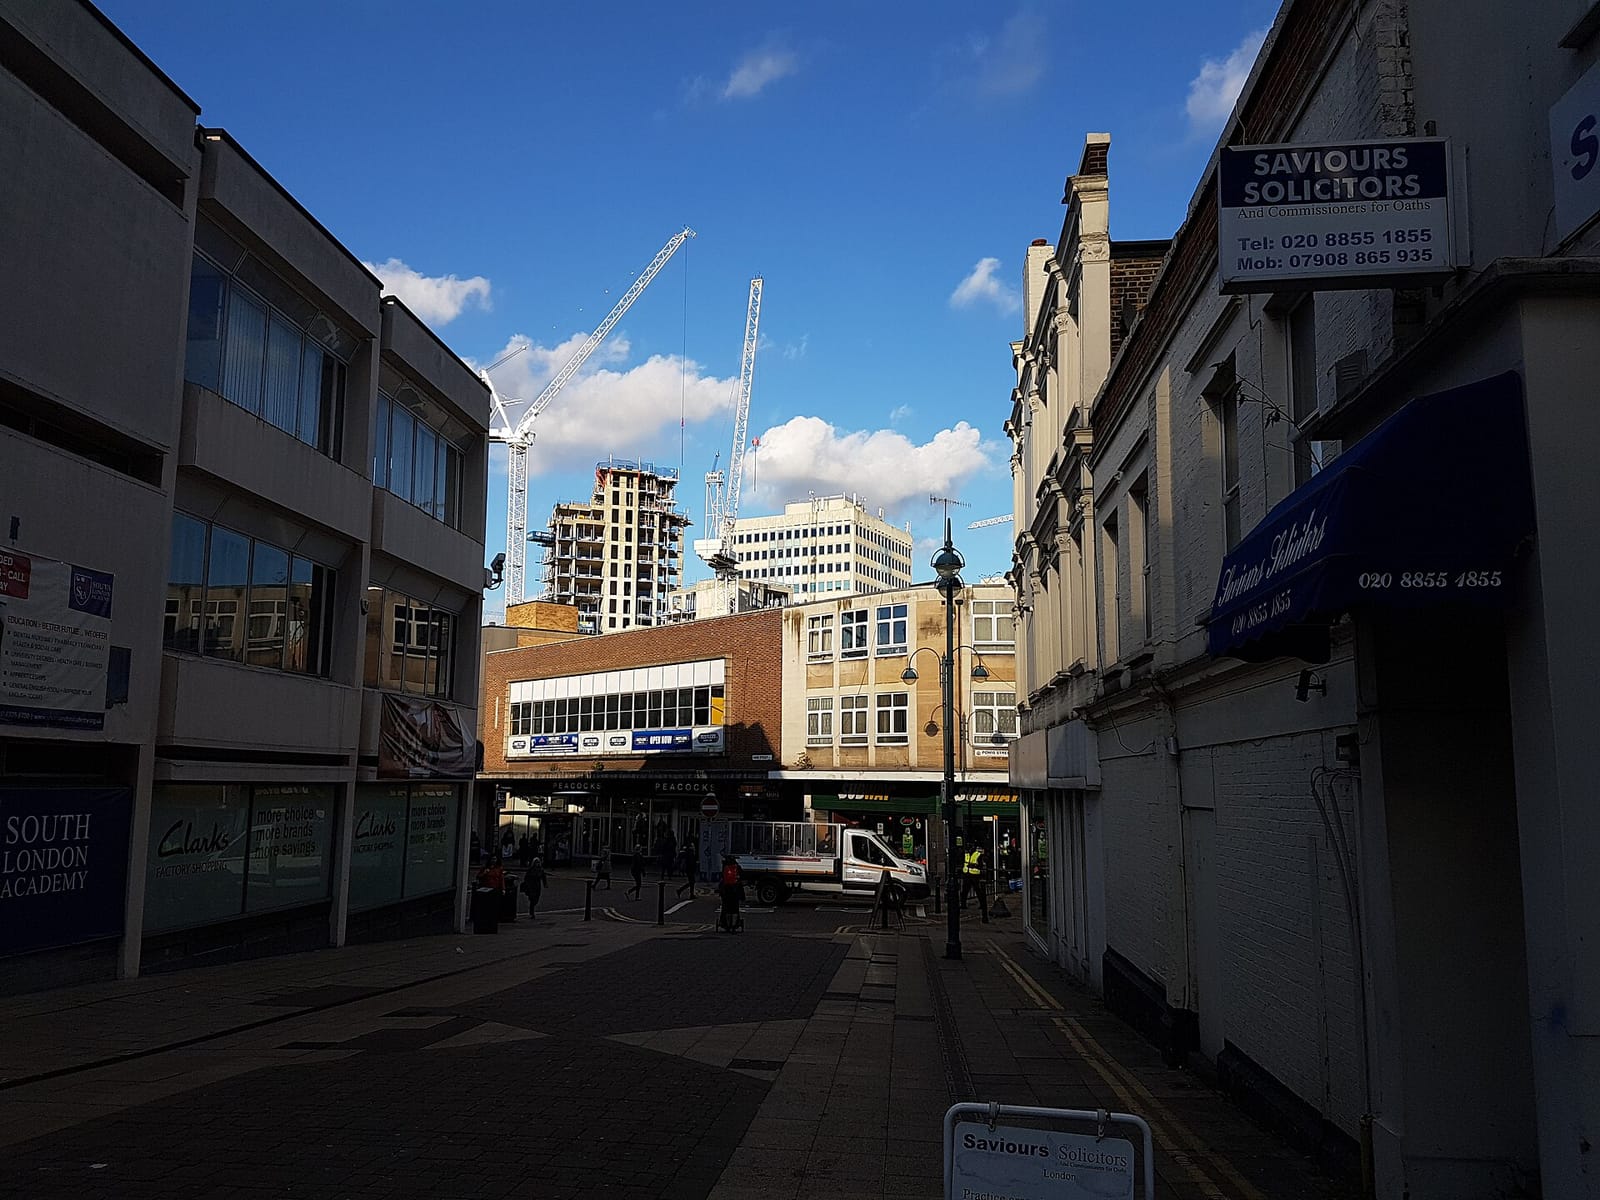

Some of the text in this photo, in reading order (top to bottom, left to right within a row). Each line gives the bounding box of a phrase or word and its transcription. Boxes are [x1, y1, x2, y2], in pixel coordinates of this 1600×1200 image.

[1254, 147, 1408, 176] SAVIOURS
[1244, 174, 1420, 204] SOLICITORS
[1238, 200, 1430, 218] And Commissioners for Oaths
[1238, 229, 1432, 250] Tel: 020 8855 1855
[1237, 249, 1432, 270] Mob: 07908 865 935
[8, 571, 24, 582] CALL
[1358, 570, 1502, 589] 020 8855 1855
[8, 616, 37, 628] EDUCATION
[552, 782, 600, 790] PEACOCKS
[655, 783, 717, 792] PEACOCKS
[837, 785, 891, 801] SUBWAY
[954, 785, 1019, 802] SUBWAY
[257, 808, 314, 822] more choice
[412, 807, 426, 816] more
[5, 813, 93, 844] SOUTH
[256, 822, 312, 840] more brands
[356, 811, 395, 838] Clarks
[158, 820, 228, 857] Clarks
[256, 840, 316, 858] more savings
[2, 846, 88, 874] LONDON
[156, 860, 226, 878] FACTORY SHOPPING
[0, 870, 88, 898] ACADEMY
[964, 1134, 1049, 1157] Saviours
[1058, 1146, 1127, 1166] Solicitors
[1043, 1169, 1076, 1181] London
[963, 1188, 1006, 1200] Practice
